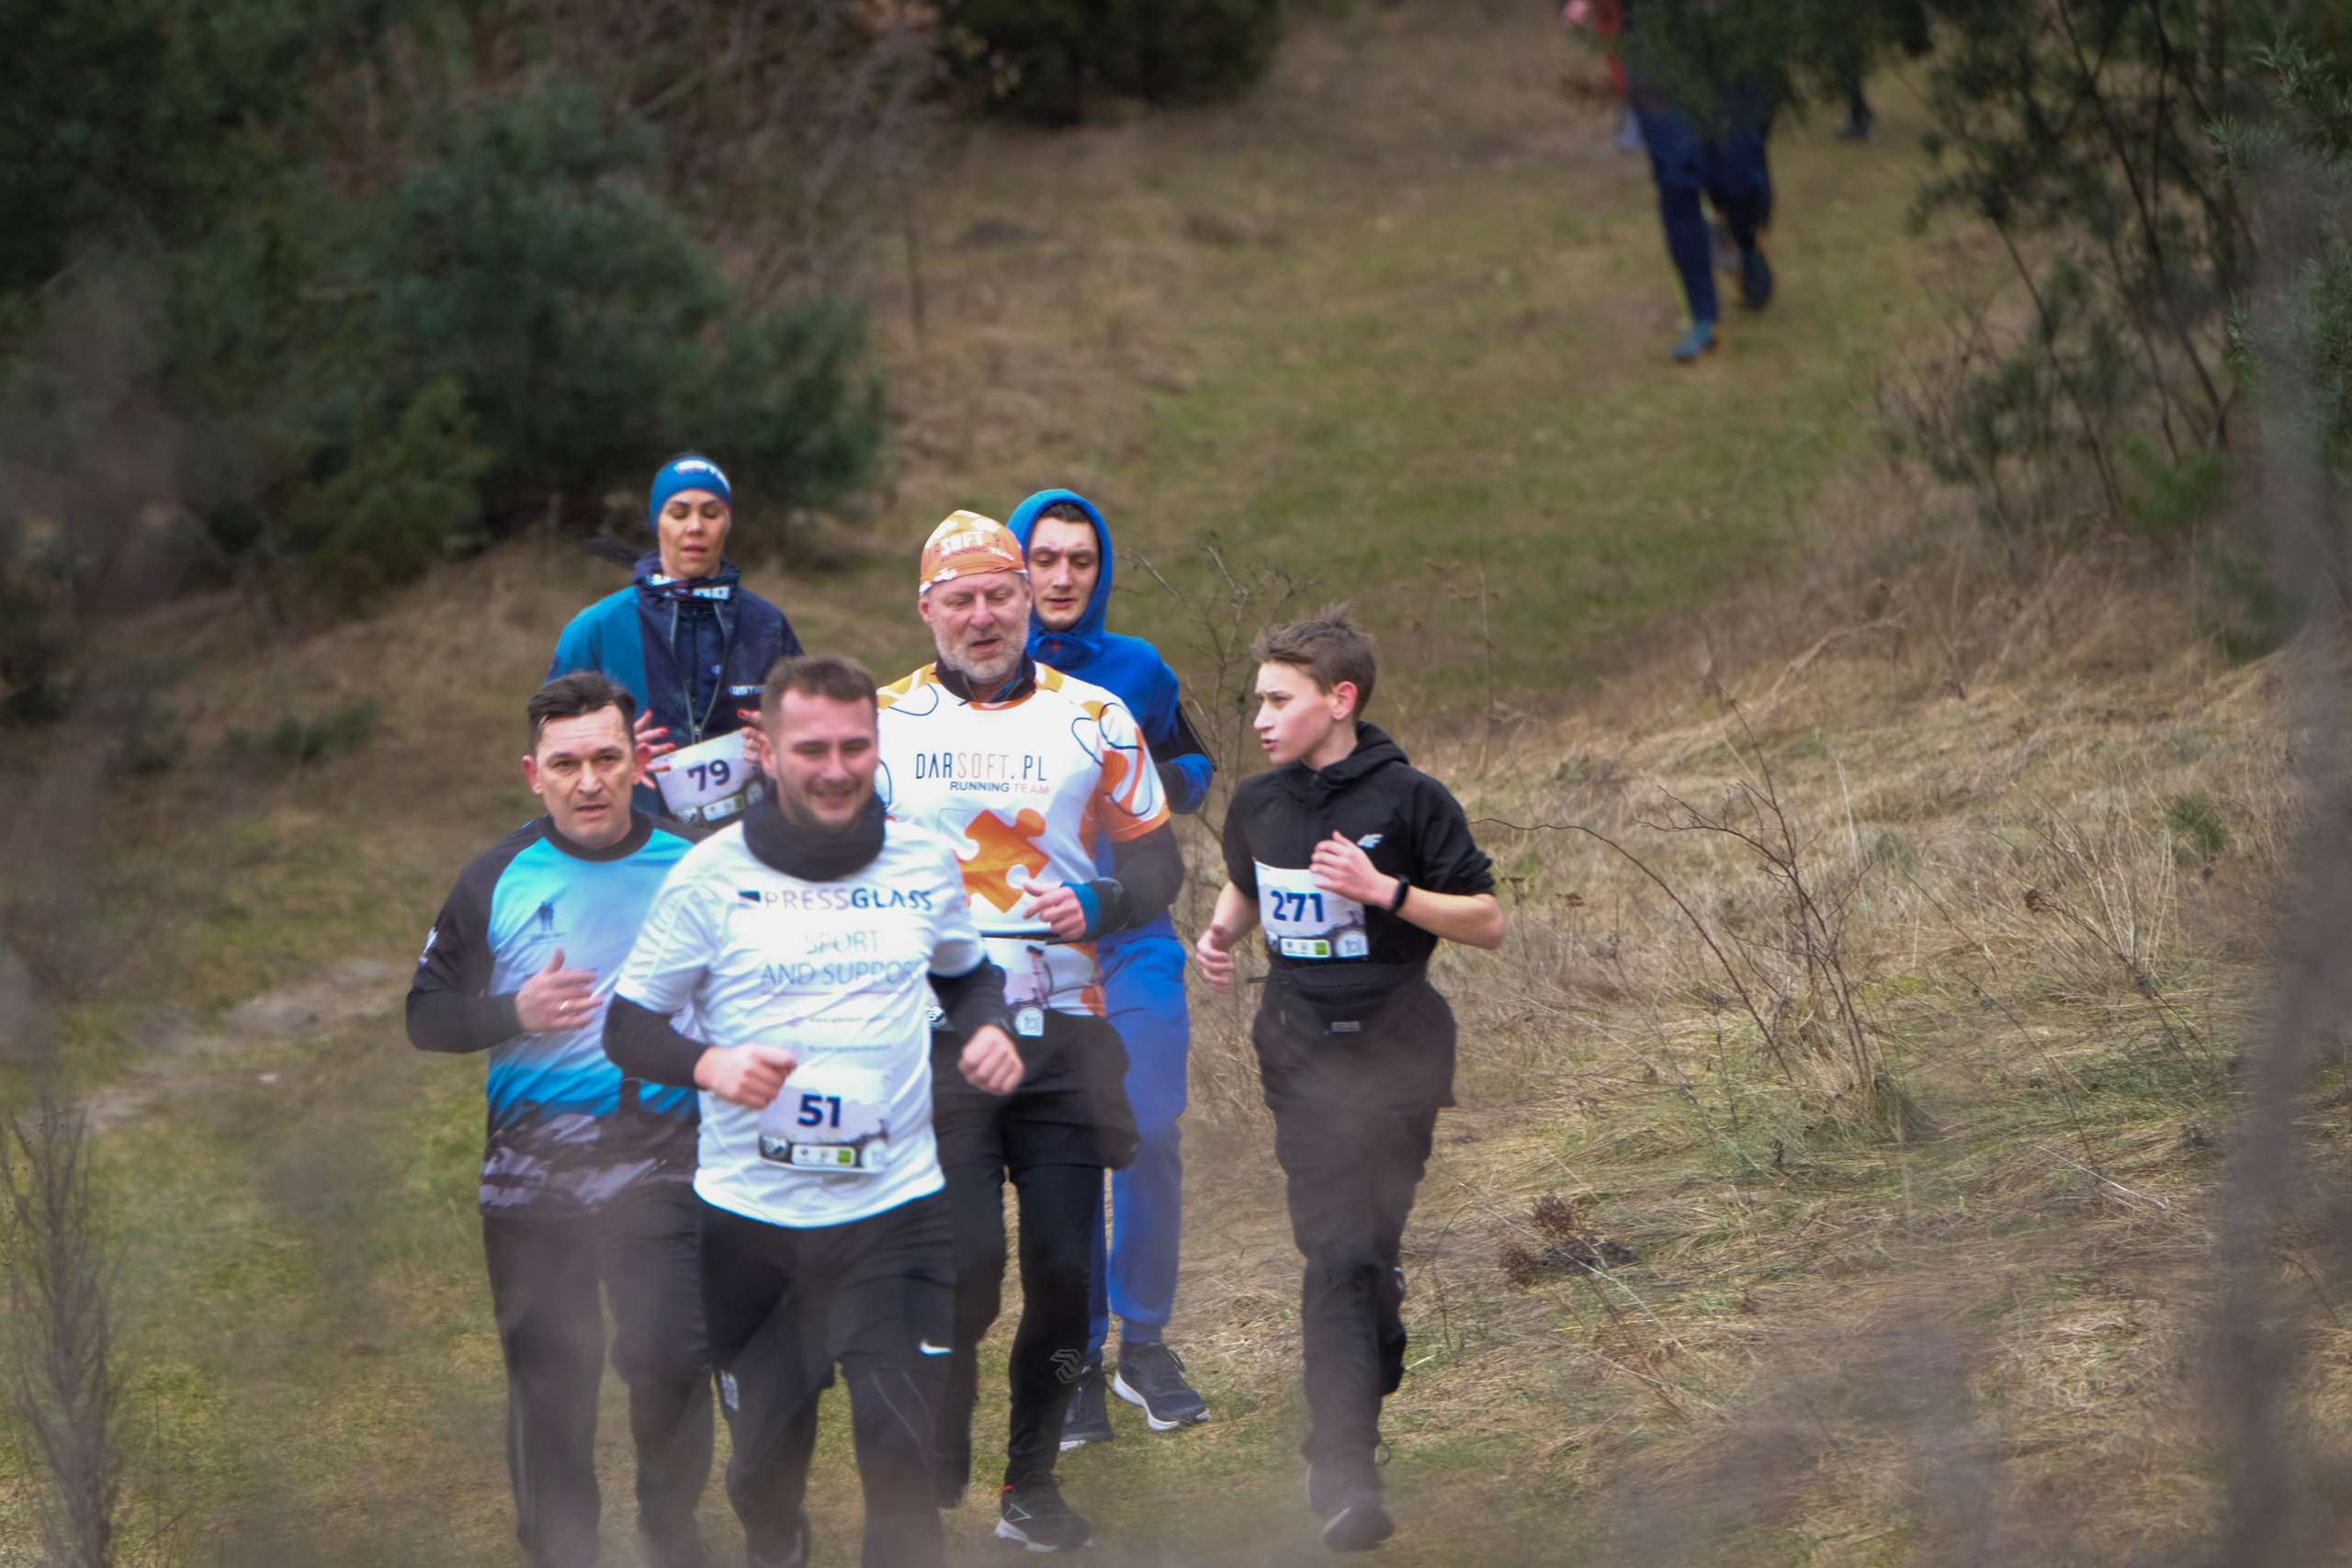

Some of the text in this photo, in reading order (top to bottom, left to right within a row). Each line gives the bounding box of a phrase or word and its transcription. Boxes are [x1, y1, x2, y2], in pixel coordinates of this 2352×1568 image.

[687, 759, 730, 792] 79
[915, 751, 1047, 782] DARSOFT.PL
[949, 781, 1050, 795] RUNNING TEAM
[1271, 890, 1324, 922] 271
[806, 929, 879, 954] SPORT
[761, 962, 817, 987] AND
[797, 1093, 842, 1128] 51
